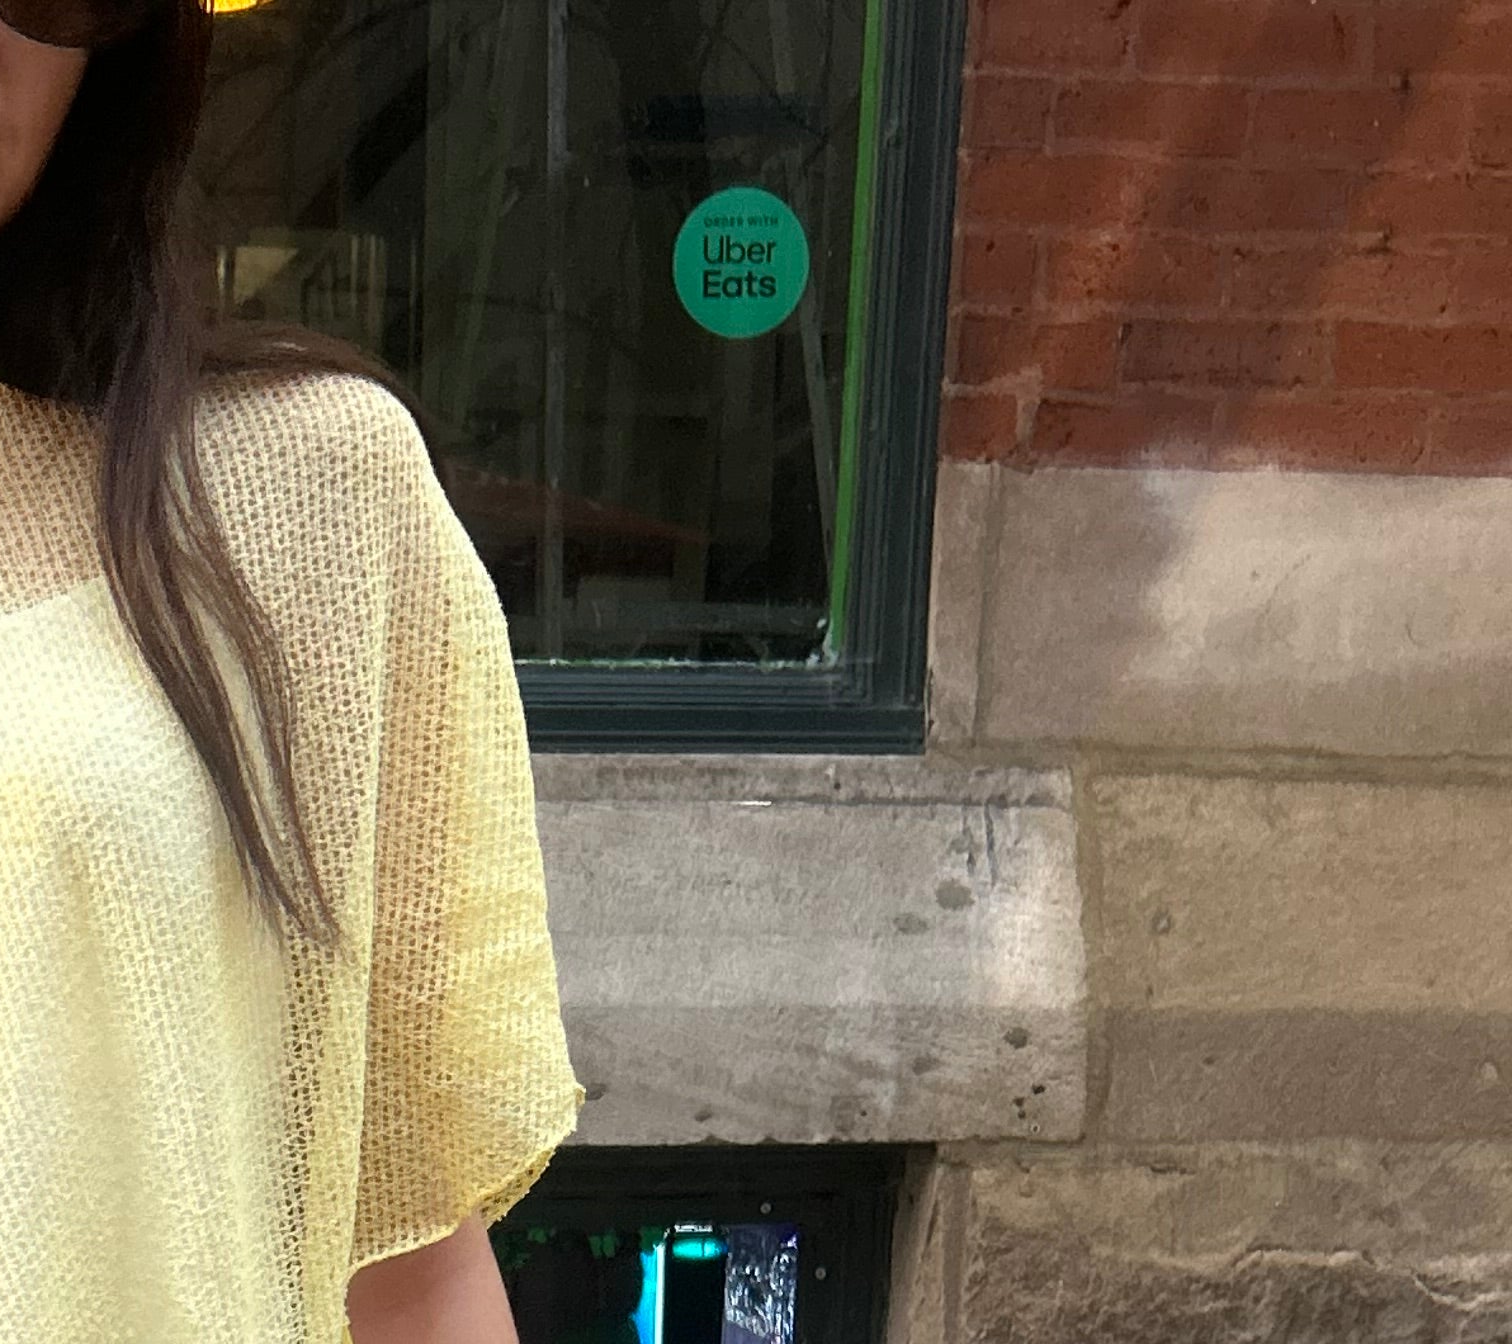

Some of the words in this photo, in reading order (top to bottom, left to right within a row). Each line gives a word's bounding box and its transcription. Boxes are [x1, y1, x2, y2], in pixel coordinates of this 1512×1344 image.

[747, 215, 779, 227] WITH
[703, 235, 777, 265] Uber
[702, 270, 777, 298] Eats
